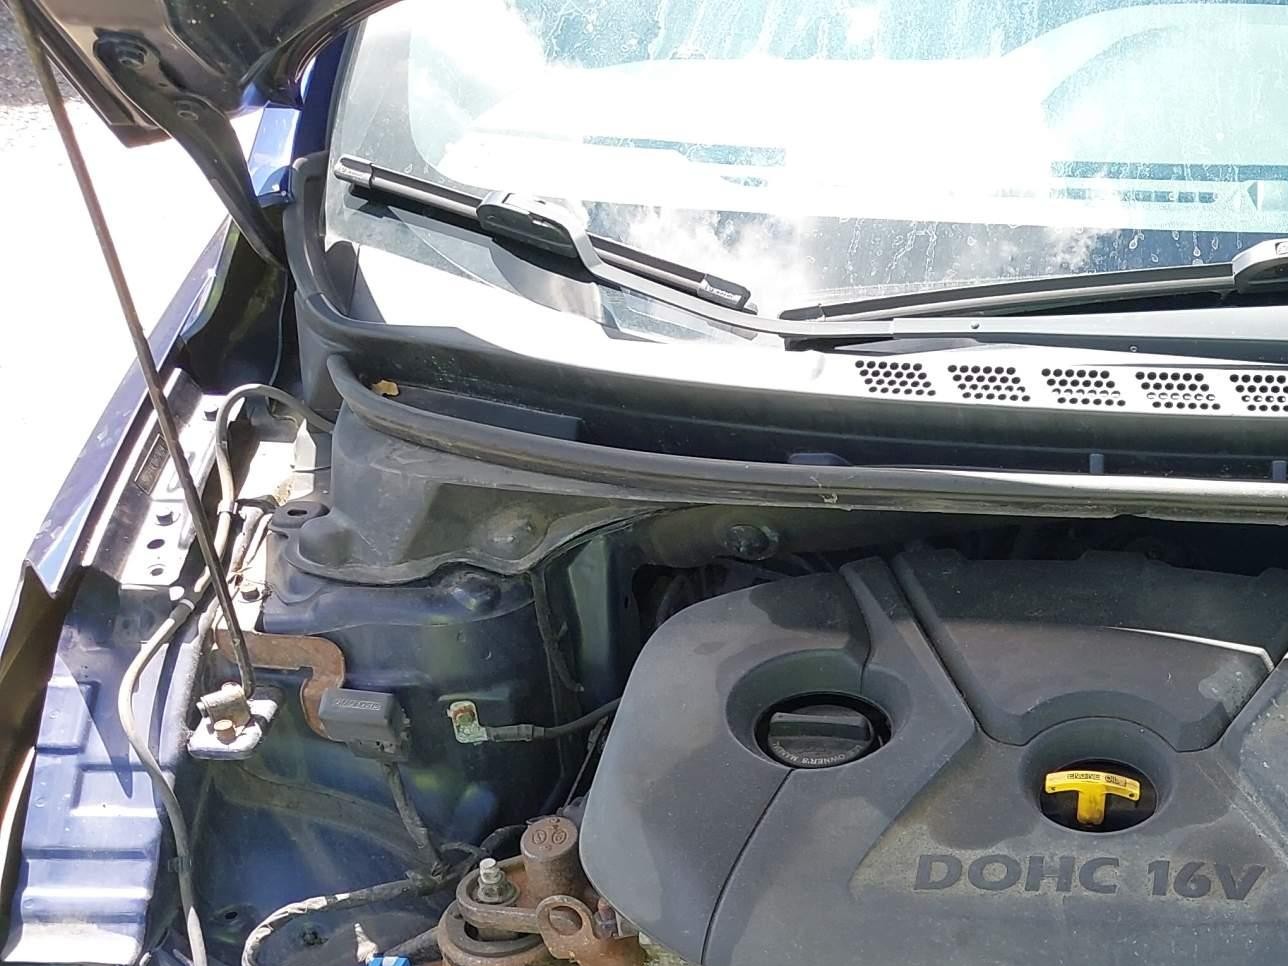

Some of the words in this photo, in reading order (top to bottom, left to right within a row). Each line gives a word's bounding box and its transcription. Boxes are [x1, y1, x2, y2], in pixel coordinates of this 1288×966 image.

[1066, 772, 1101, 780] ENGINE
[1104, 774, 1120, 784] OIL
[914, 854, 1120, 894] DOHC
[1148, 860, 1265, 901] 16V
